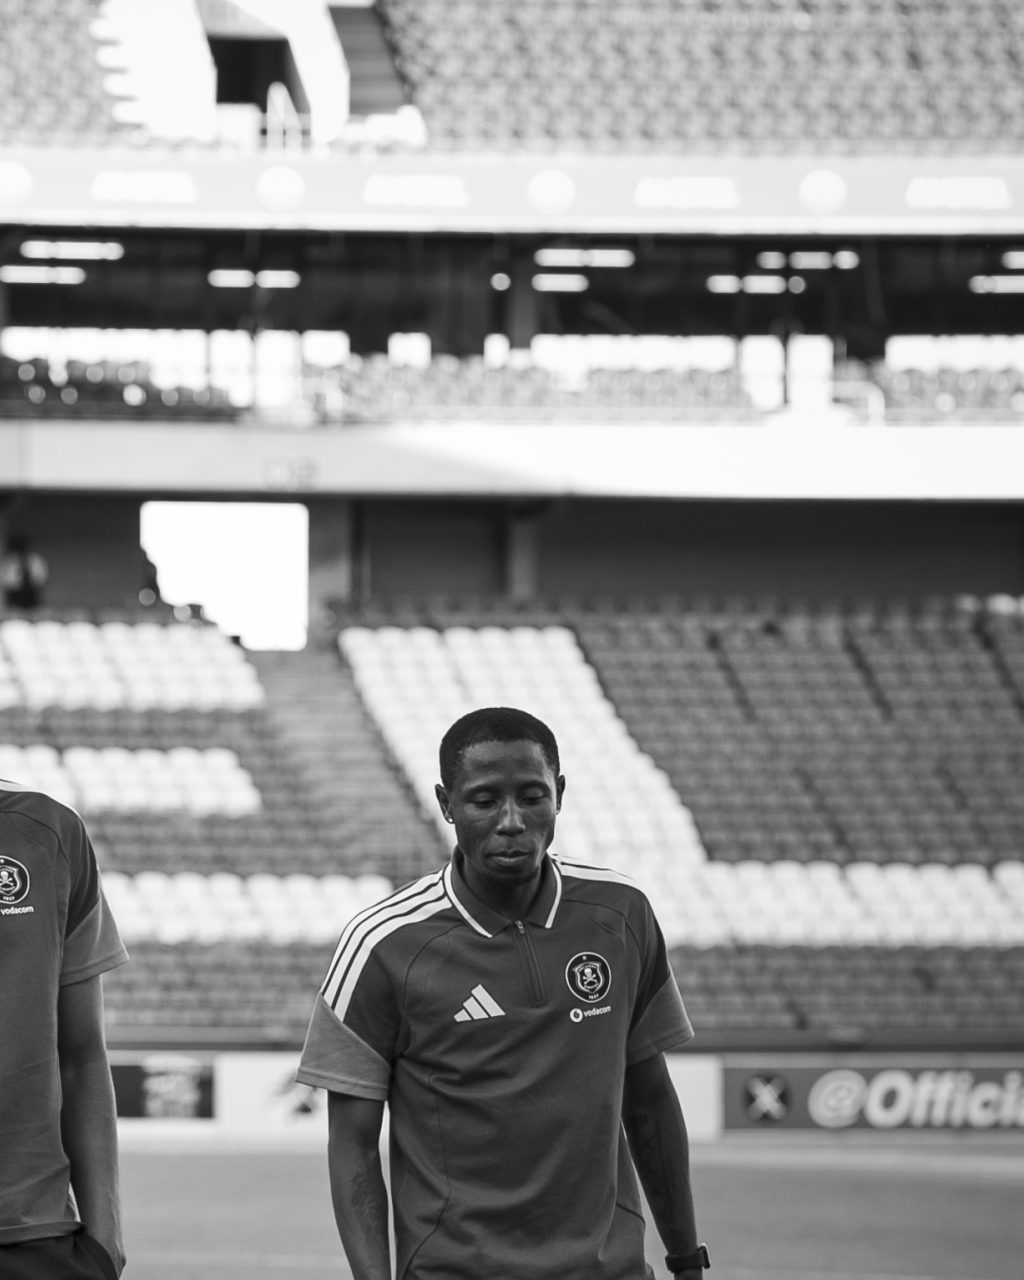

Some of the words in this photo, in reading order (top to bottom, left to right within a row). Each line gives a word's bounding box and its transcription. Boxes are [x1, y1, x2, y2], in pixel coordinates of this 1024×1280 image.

[0, 906, 35, 916] vodacom
[583, 1005, 612, 1018] vodacom
[807, 1068, 1024, 1128] @Offici
